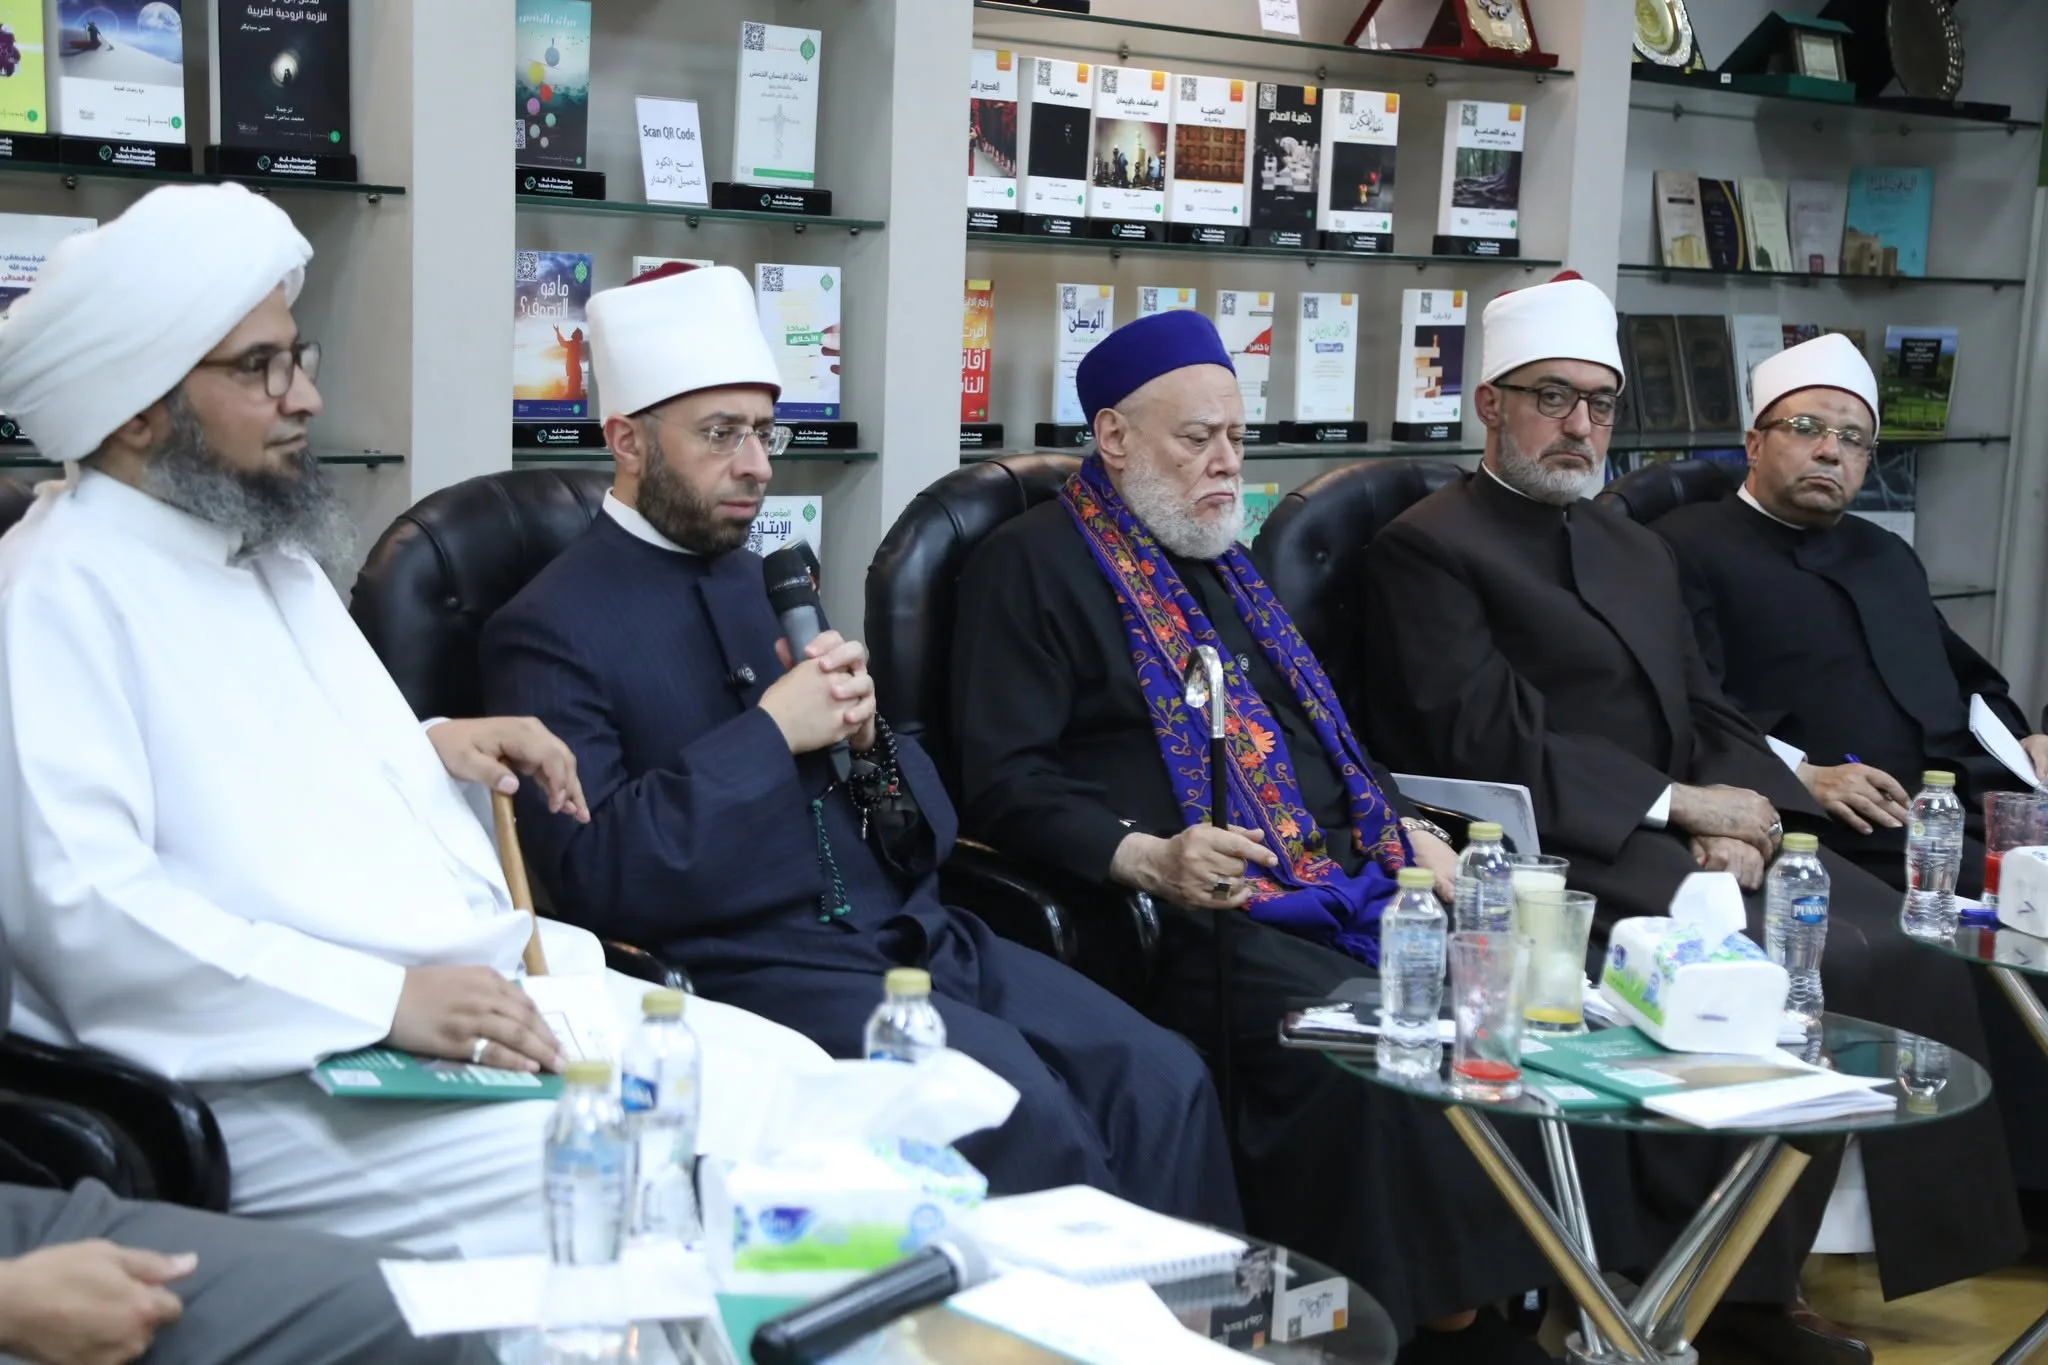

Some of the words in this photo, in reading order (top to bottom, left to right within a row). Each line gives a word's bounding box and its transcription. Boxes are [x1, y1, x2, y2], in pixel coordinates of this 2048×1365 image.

[247, 5, 274, 18] الغربية
[276, 8, 304, 21] الروحية
[306, 11, 328, 24] الأزمة
[1268, 110, 1291, 123] الصدام
[1290, 111, 1312, 125] حتمية
[643, 124, 661, 138] Scan
[663, 126, 675, 140] QR
[676, 127, 696, 141] Code
[656, 156, 674, 169] الكود
[1068, 308, 1105, 334] الوطن
[789, 335, 819, 344] الأخلاق
[962, 347, 986, 372] أقات
[961, 376, 984, 394] النا
